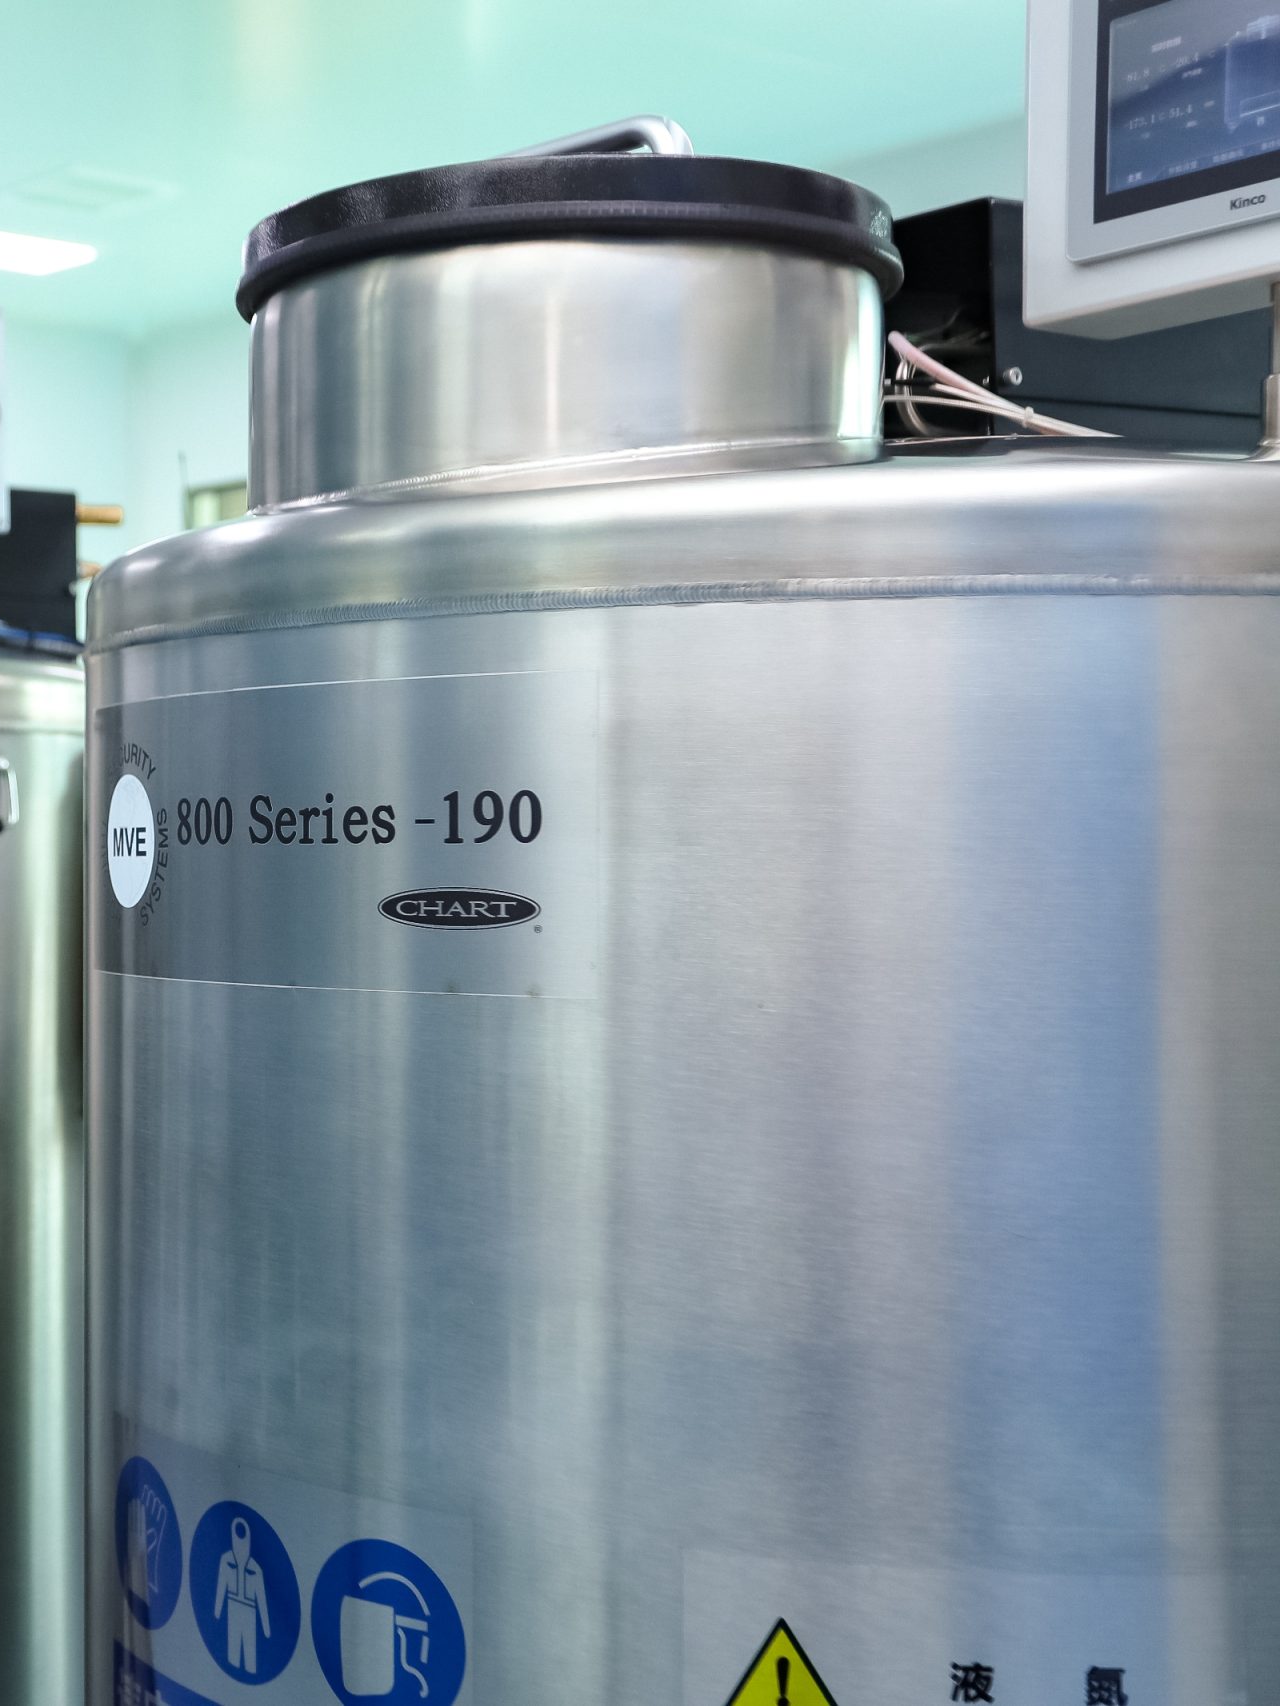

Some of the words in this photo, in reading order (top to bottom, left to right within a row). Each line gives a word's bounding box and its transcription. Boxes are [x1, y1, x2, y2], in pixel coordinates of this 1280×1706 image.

[1230, 194, 1266, 211] Kinco
[177, 796, 233, 846] 800
[248, 792, 396, 845] Series
[414, 789, 543, 844] -190
[113, 826, 147, 857] MVE
[139, 807, 170, 927] SYSTEMS
[395, 899, 518, 918] CHART
[950, 1661, 995, 1704] 液
